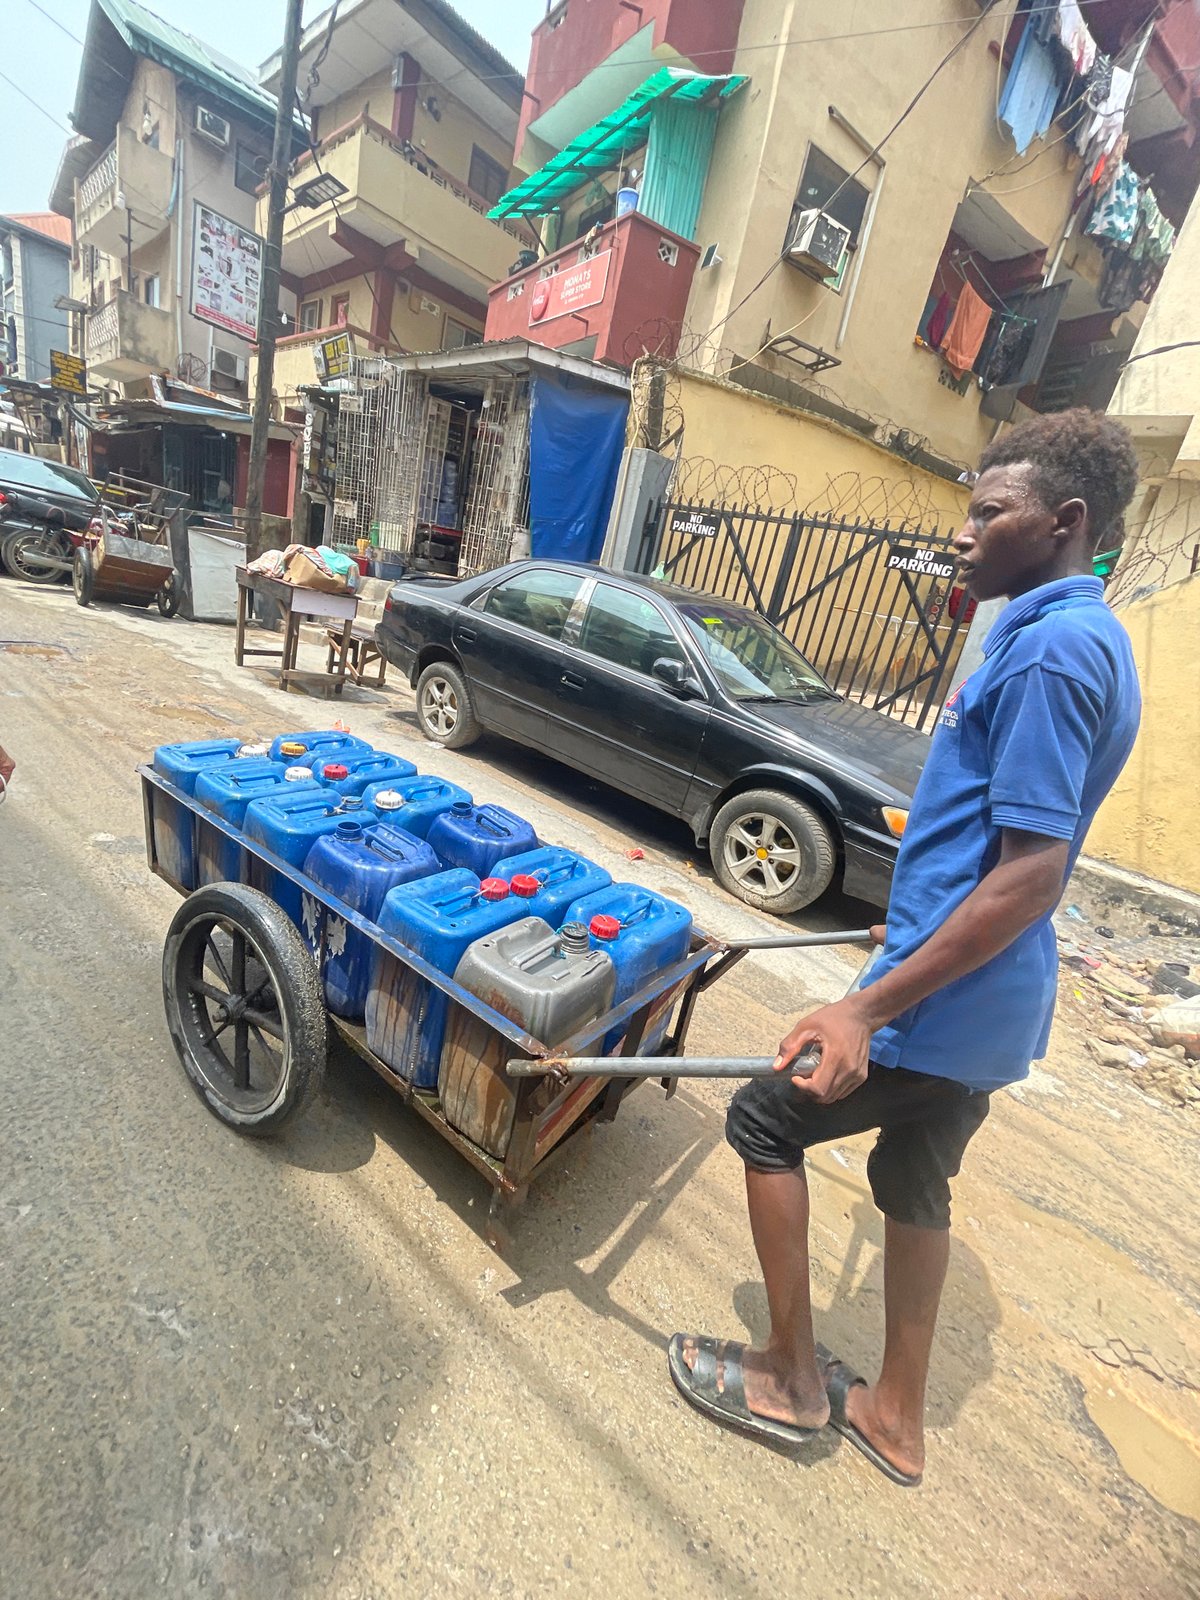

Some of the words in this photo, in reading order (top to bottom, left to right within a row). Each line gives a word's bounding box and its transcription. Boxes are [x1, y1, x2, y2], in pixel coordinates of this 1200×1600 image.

[690, 514, 703, 524] NO
[672, 520, 716, 536] PARKING
[914, 549, 935, 561] NO
[888, 555, 954, 577] PARKING
